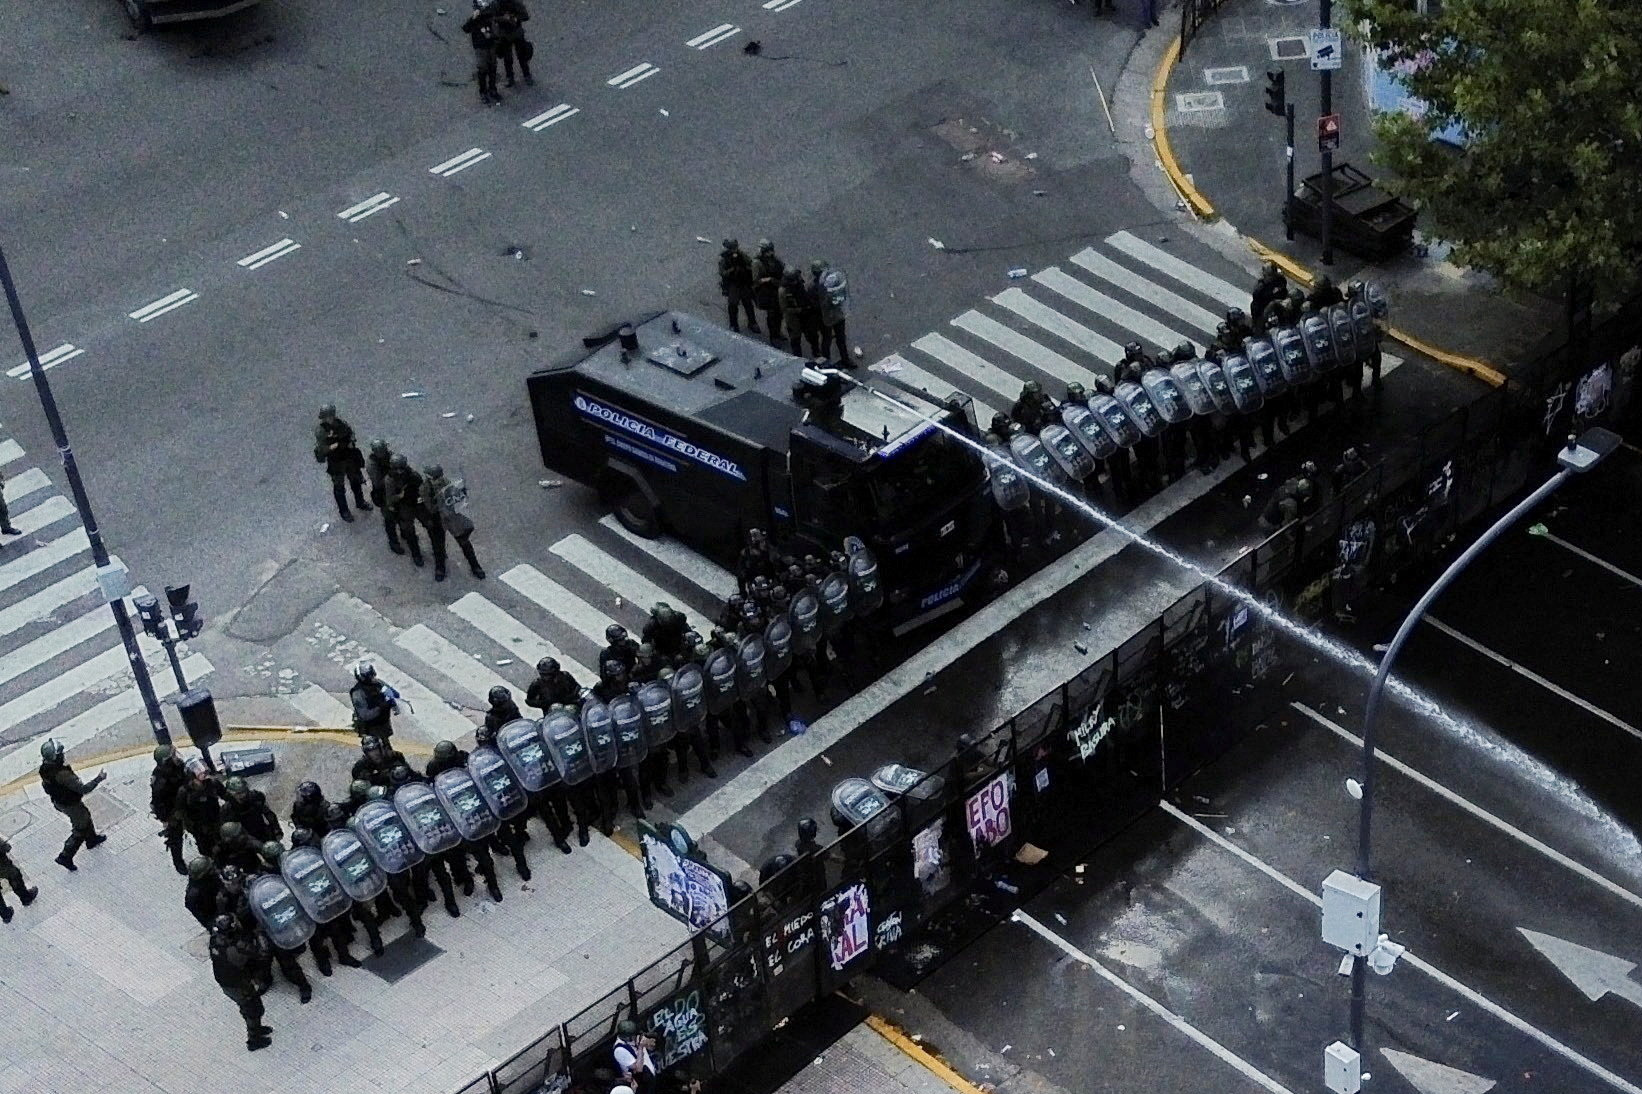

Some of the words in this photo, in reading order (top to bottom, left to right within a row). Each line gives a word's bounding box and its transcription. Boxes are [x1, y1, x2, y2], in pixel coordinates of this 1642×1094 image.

[589, 402, 656, 440] POLICIA
[663, 433, 739, 475] FEDERAL
[969, 780, 1005, 829] EFO
